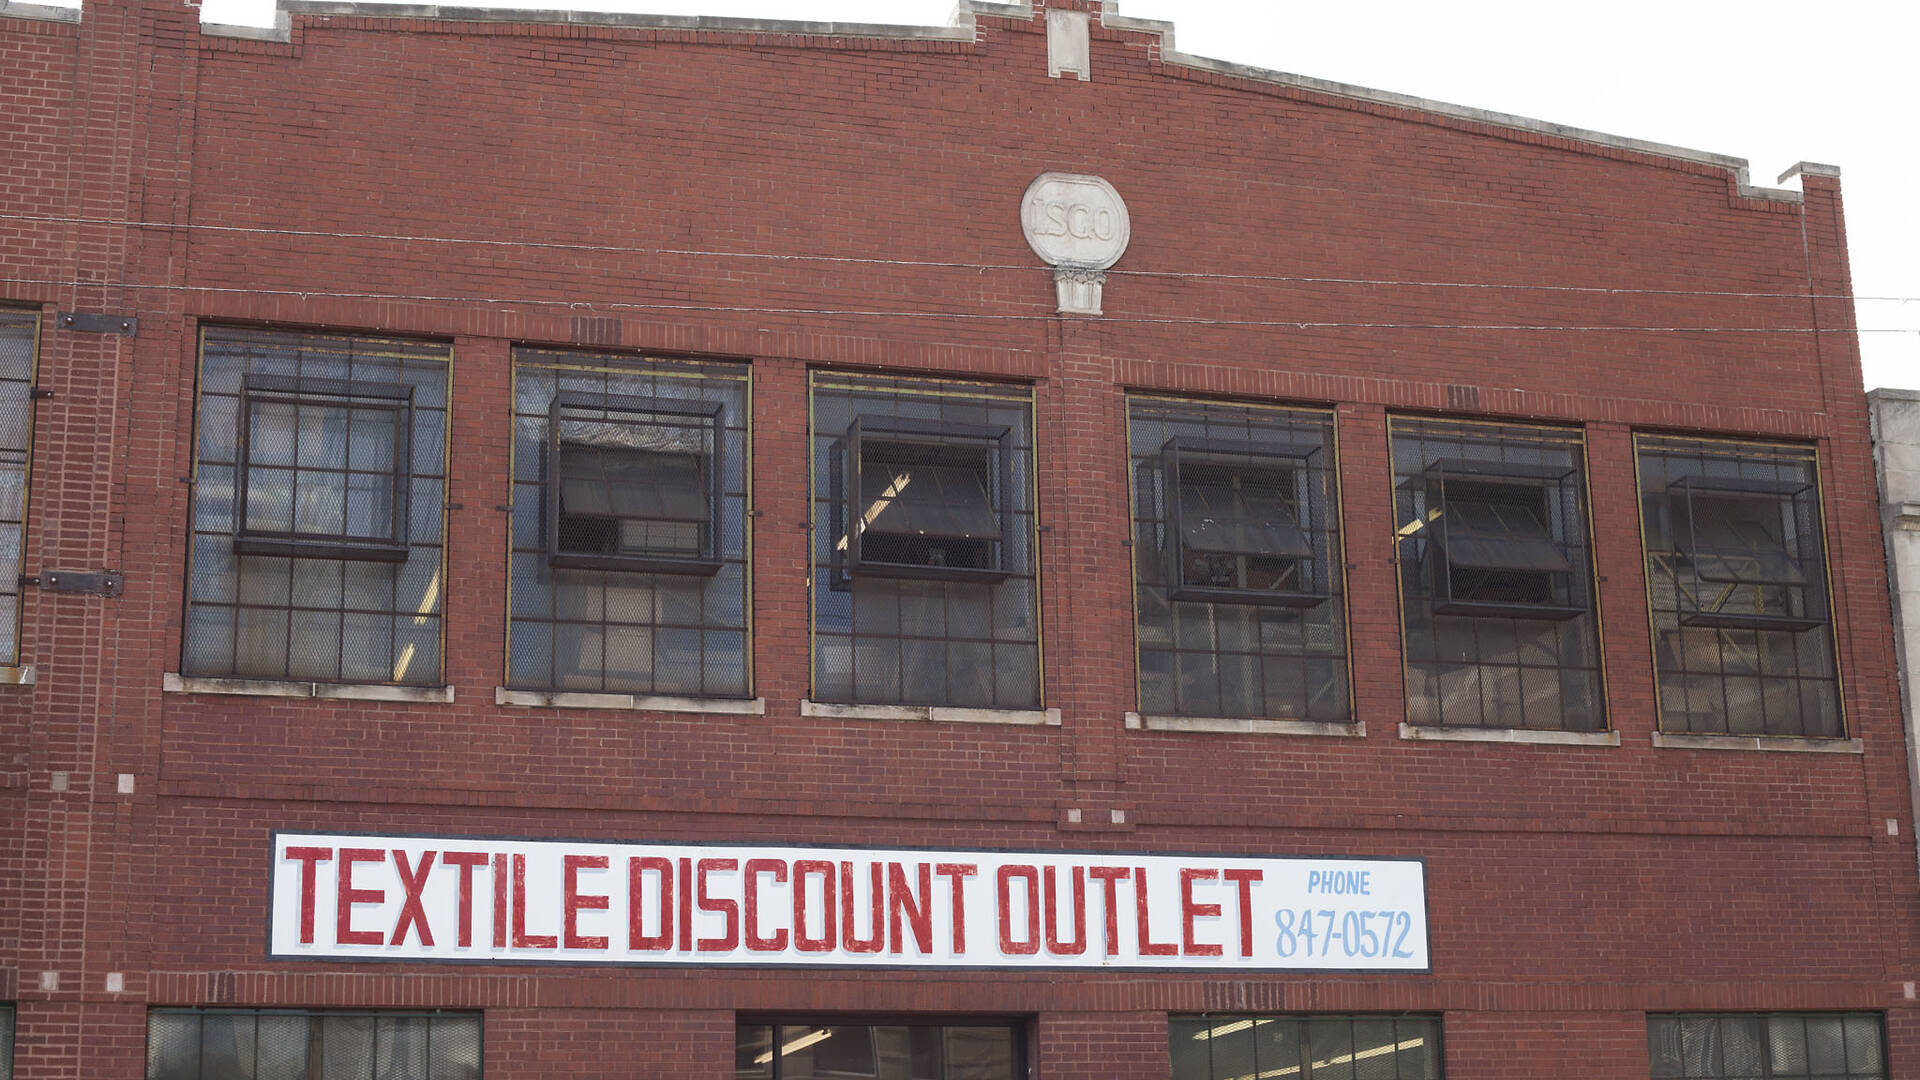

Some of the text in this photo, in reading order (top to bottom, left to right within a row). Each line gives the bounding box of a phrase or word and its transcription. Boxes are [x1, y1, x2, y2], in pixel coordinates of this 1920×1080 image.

[285, 846, 1264, 957] TEXTILE DISCOUNT OUTLET
[1307, 869, 1371, 896] PHONE
[1275, 908, 1414, 959] 847-0572
